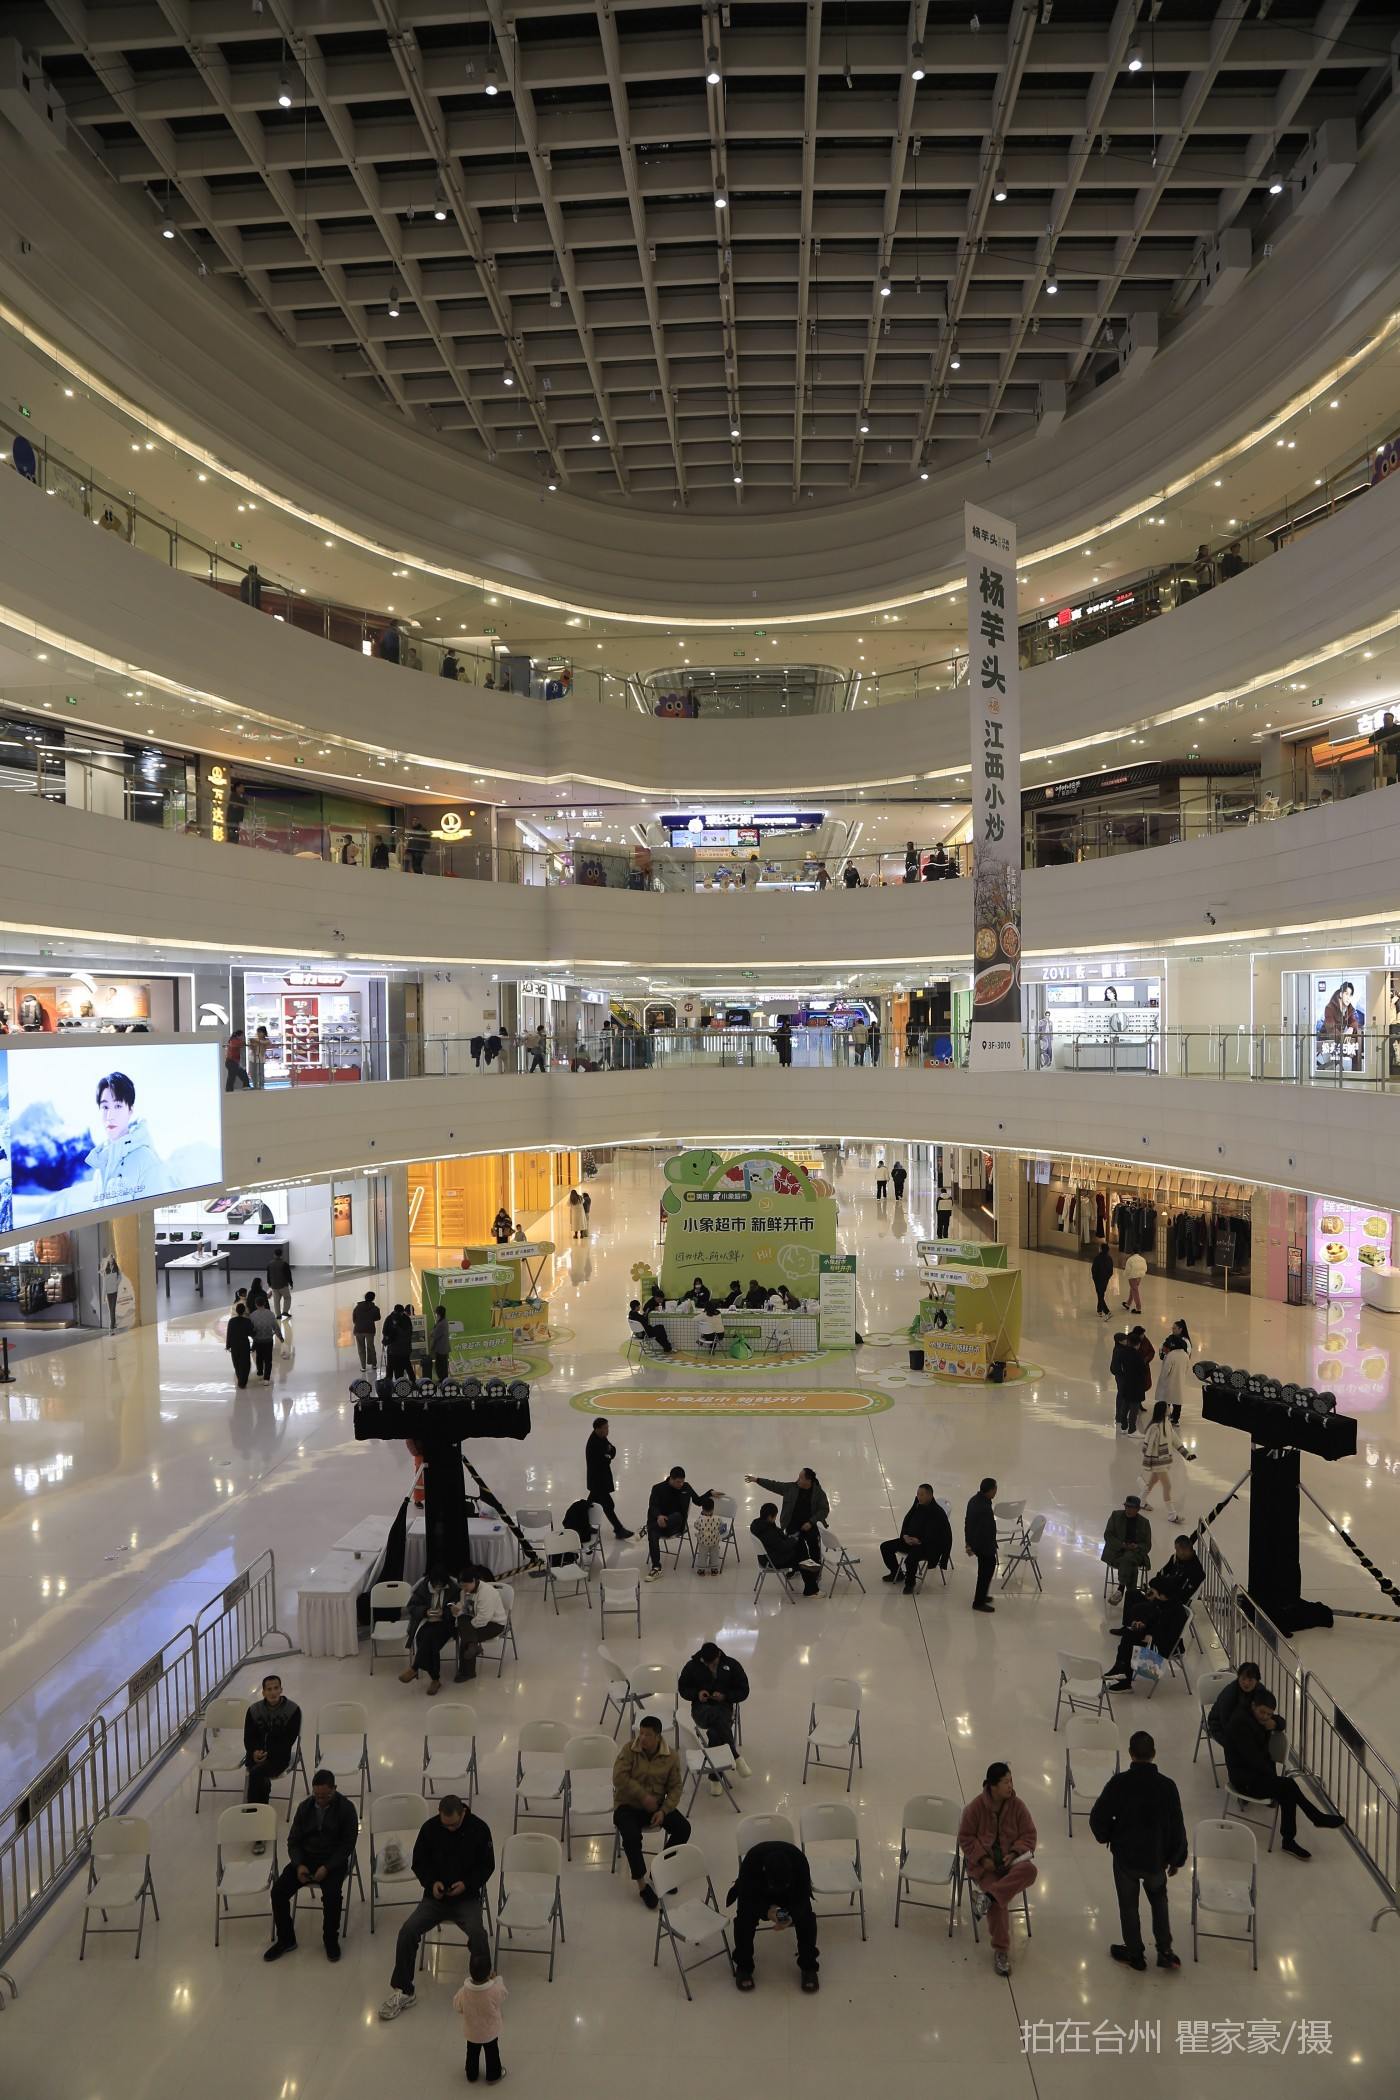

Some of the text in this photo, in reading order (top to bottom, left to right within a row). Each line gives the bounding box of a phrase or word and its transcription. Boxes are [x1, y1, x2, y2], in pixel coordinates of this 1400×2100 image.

[972, 525, 998, 546] 杨芋头
[979, 566, 1006, 694] 杨芋头
[983, 719, 1005, 842] 江西小炒
[988, 1041, 1011, 1050] 3F-3010
[721, 1191, 748, 1201] 小象超市
[683, 1217, 814, 1233] 小象超市 新鲜开市
